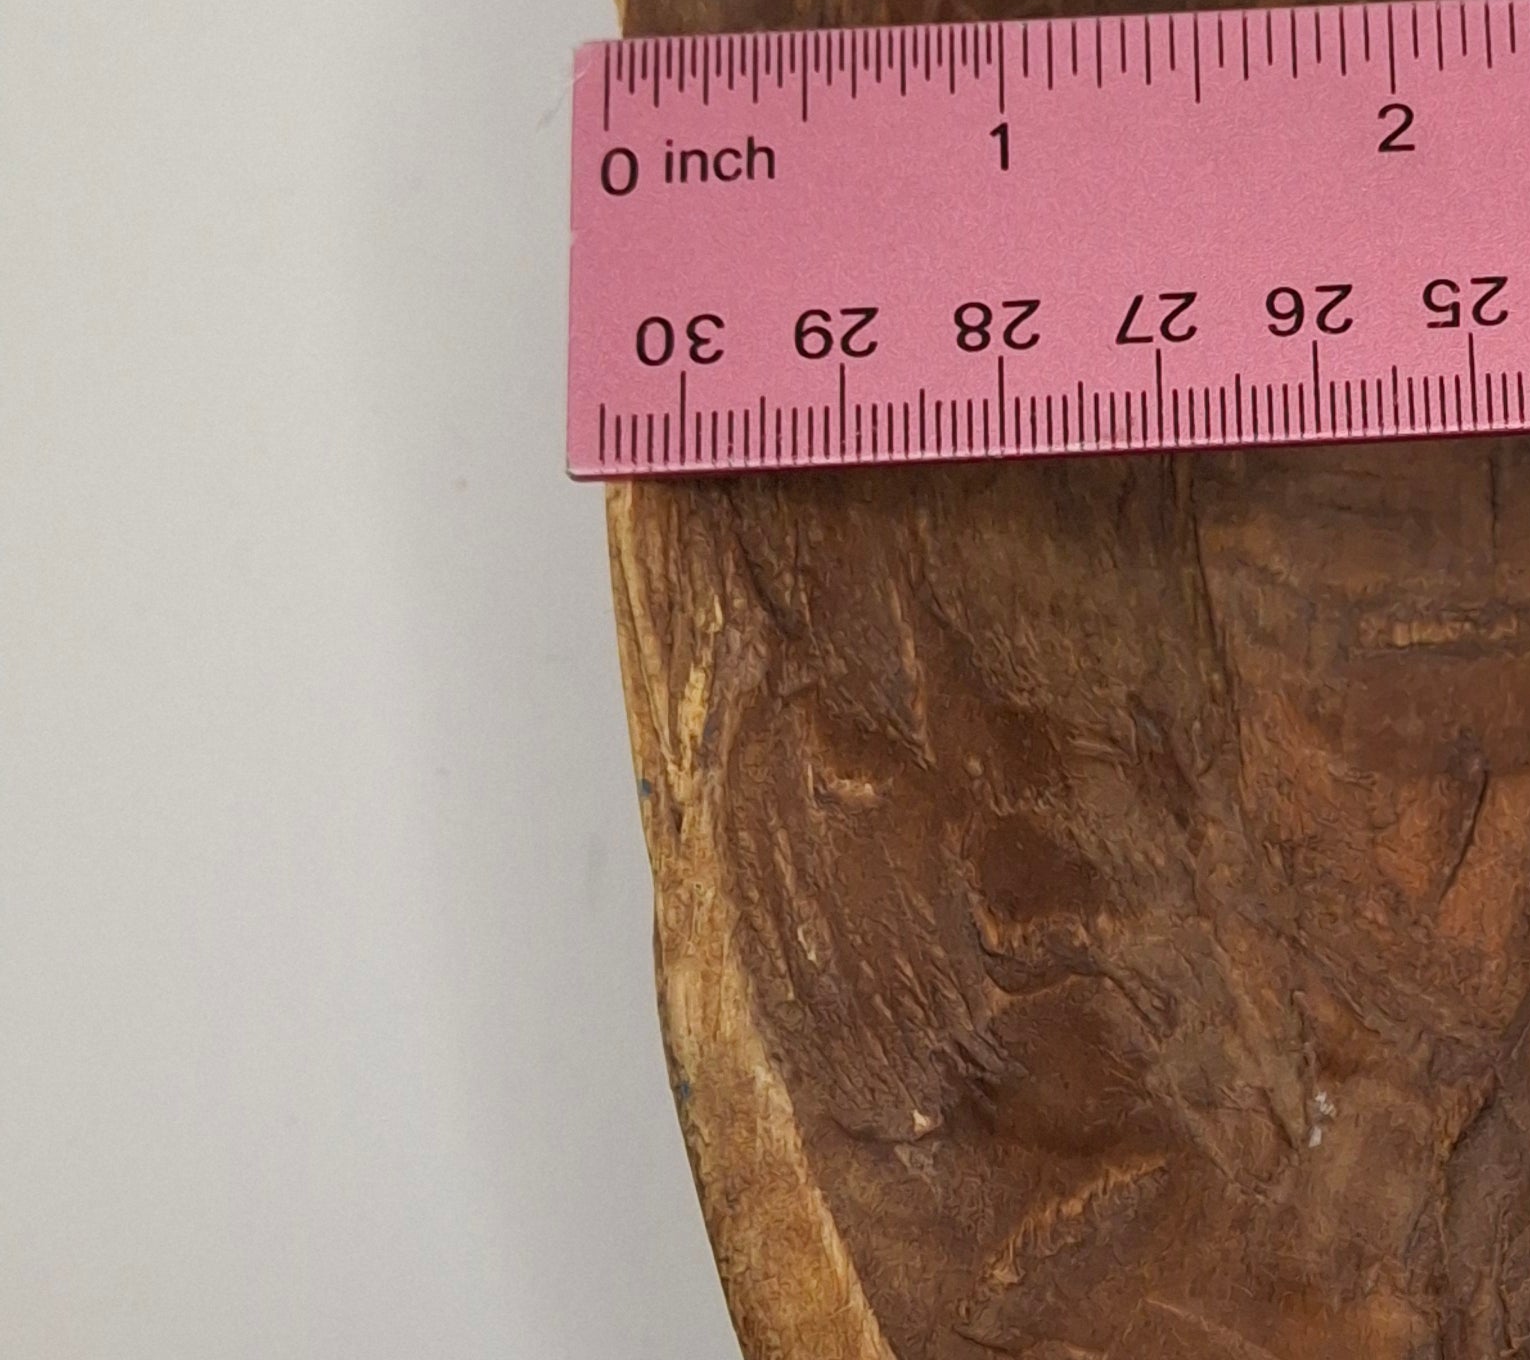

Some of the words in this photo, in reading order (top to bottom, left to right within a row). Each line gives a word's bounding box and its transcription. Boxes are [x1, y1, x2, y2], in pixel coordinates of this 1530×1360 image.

[601, 146, 638, 196] 0
[664, 136, 775, 184] inch
[989, 122, 1010, 171] 1
[1377, 103, 1416, 152] 2
[953, 299, 1042, 352] 28
[1114, 291, 1198, 345] 27
[1266, 284, 1354, 337] 26
[1422, 276, 1509, 329] 25
[635, 314, 726, 366] 30
[794, 306, 880, 359] 29
